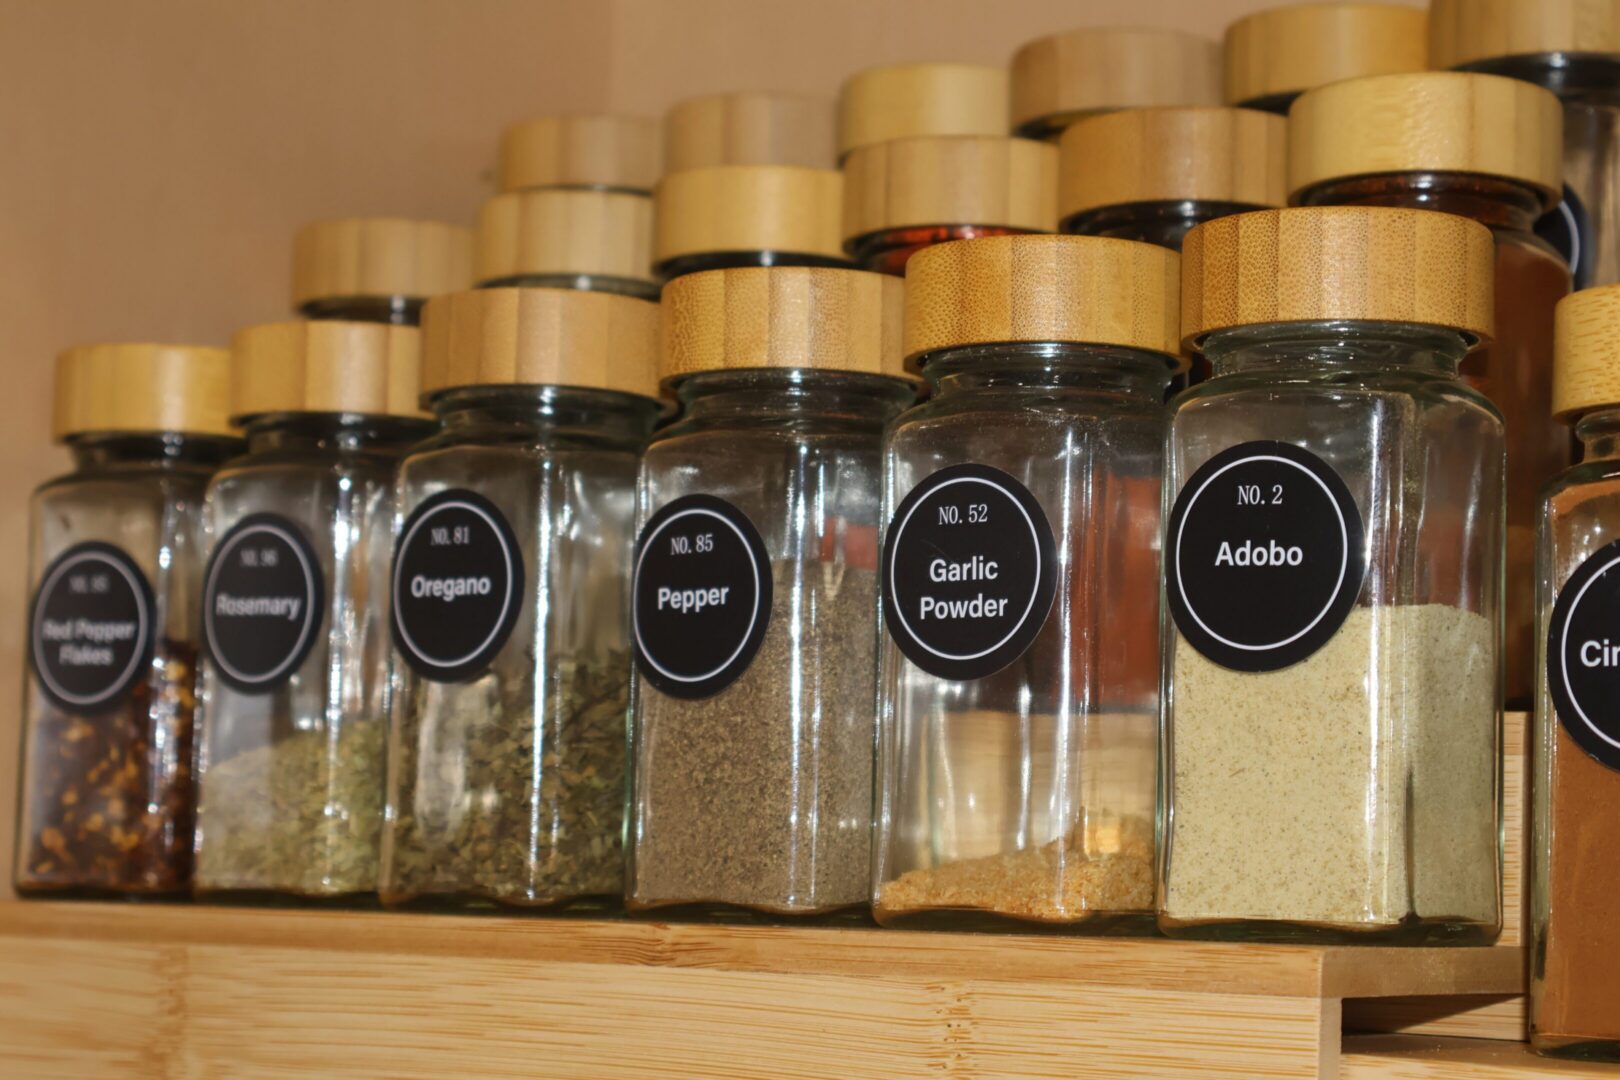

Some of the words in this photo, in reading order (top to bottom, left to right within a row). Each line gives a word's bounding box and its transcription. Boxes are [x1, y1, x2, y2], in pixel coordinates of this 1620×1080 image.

[1237, 485, 1266, 505] NO.
[1271, 484, 1284, 505] 2
[938, 505, 963, 525] NO.
[968, 503, 989, 523] 52
[453, 526, 470, 544] 81
[670, 536, 693, 556] NO.
[695, 533, 714, 553] 85
[1214, 539, 1304, 567] Adobo
[929, 555, 999, 583] Garlic
[411, 574, 491, 602] Oregano
[657, 586, 730, 614] Pepper
[215, 592, 301, 621] Rosemary
[920, 593, 1009, 620] Powder
[43, 619, 72, 640] Red
[75, 618, 135, 643] Pepper
[59, 644, 114, 666] Flakes
